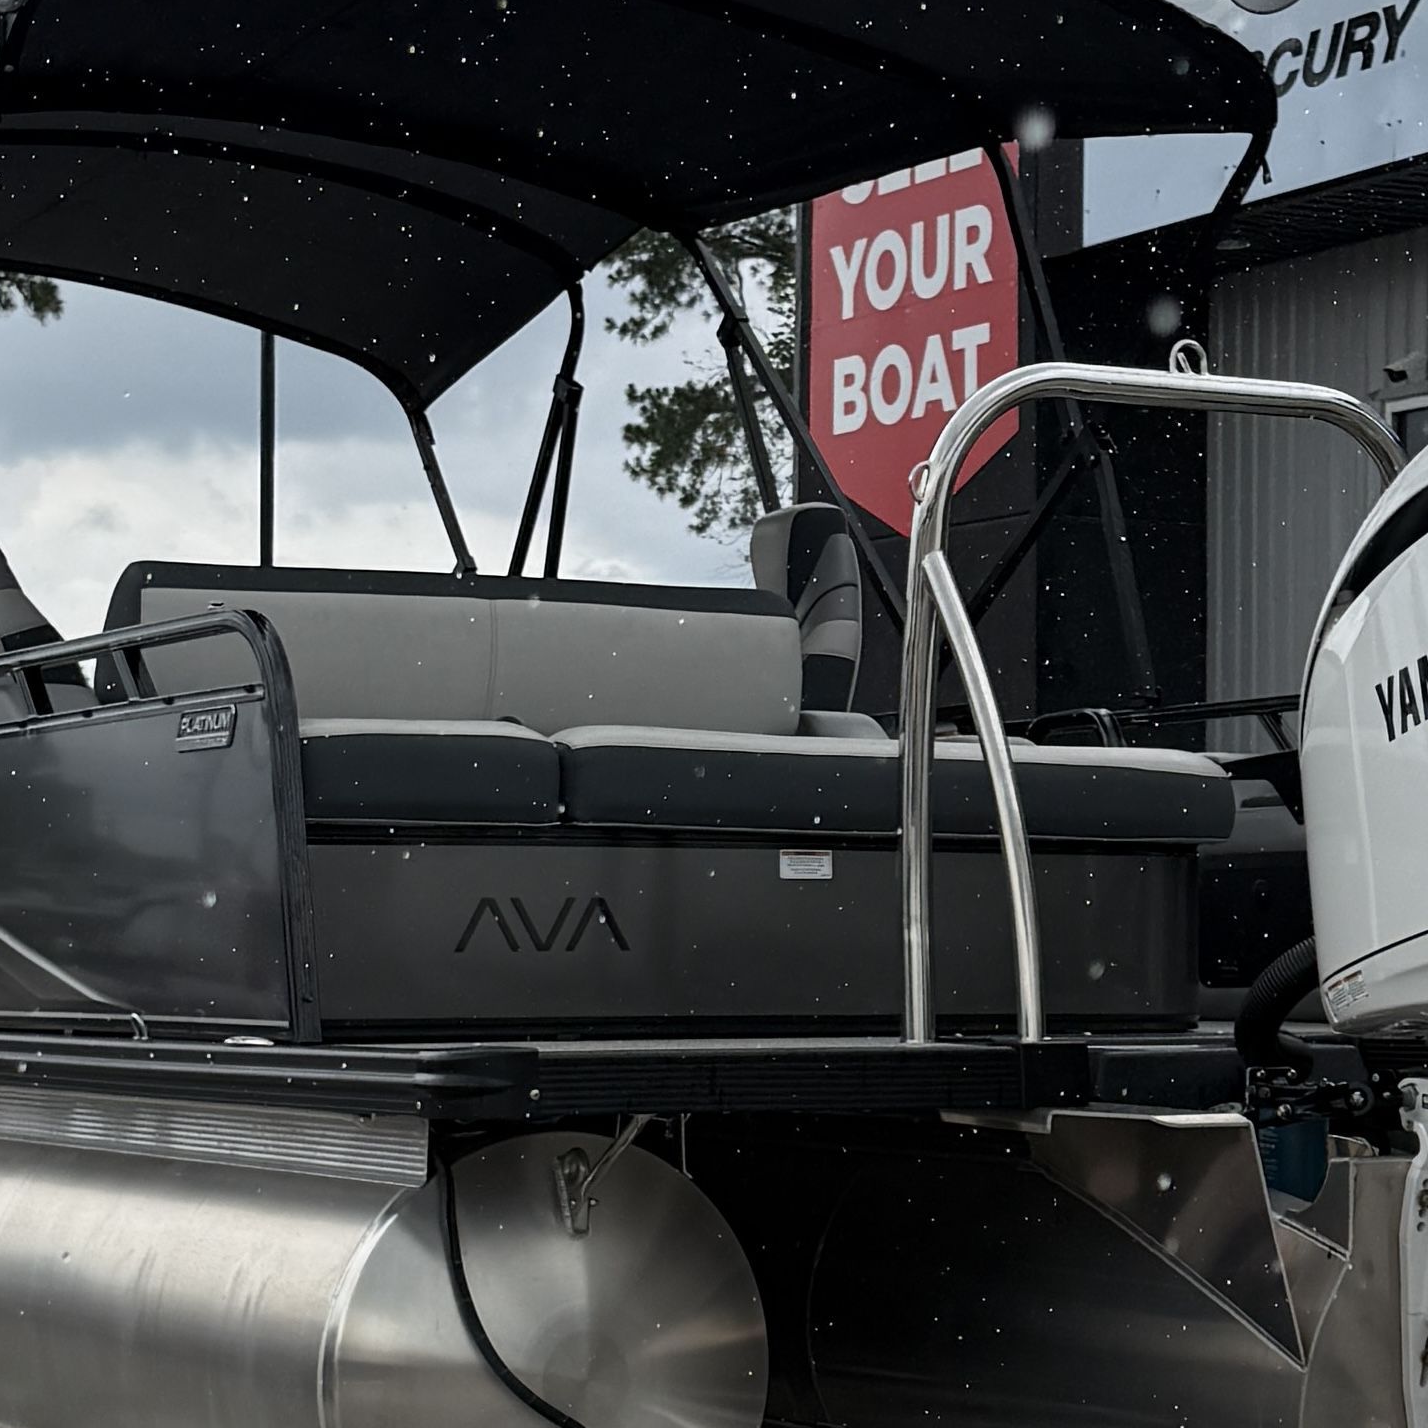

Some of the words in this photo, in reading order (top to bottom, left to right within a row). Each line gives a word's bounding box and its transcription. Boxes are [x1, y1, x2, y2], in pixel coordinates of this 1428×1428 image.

[829, 204, 993, 320] YOUR
[832, 322, 991, 436] BOAT
[180, 712, 231, 733] PLATINUM
[454, 897, 631, 953] AVA
